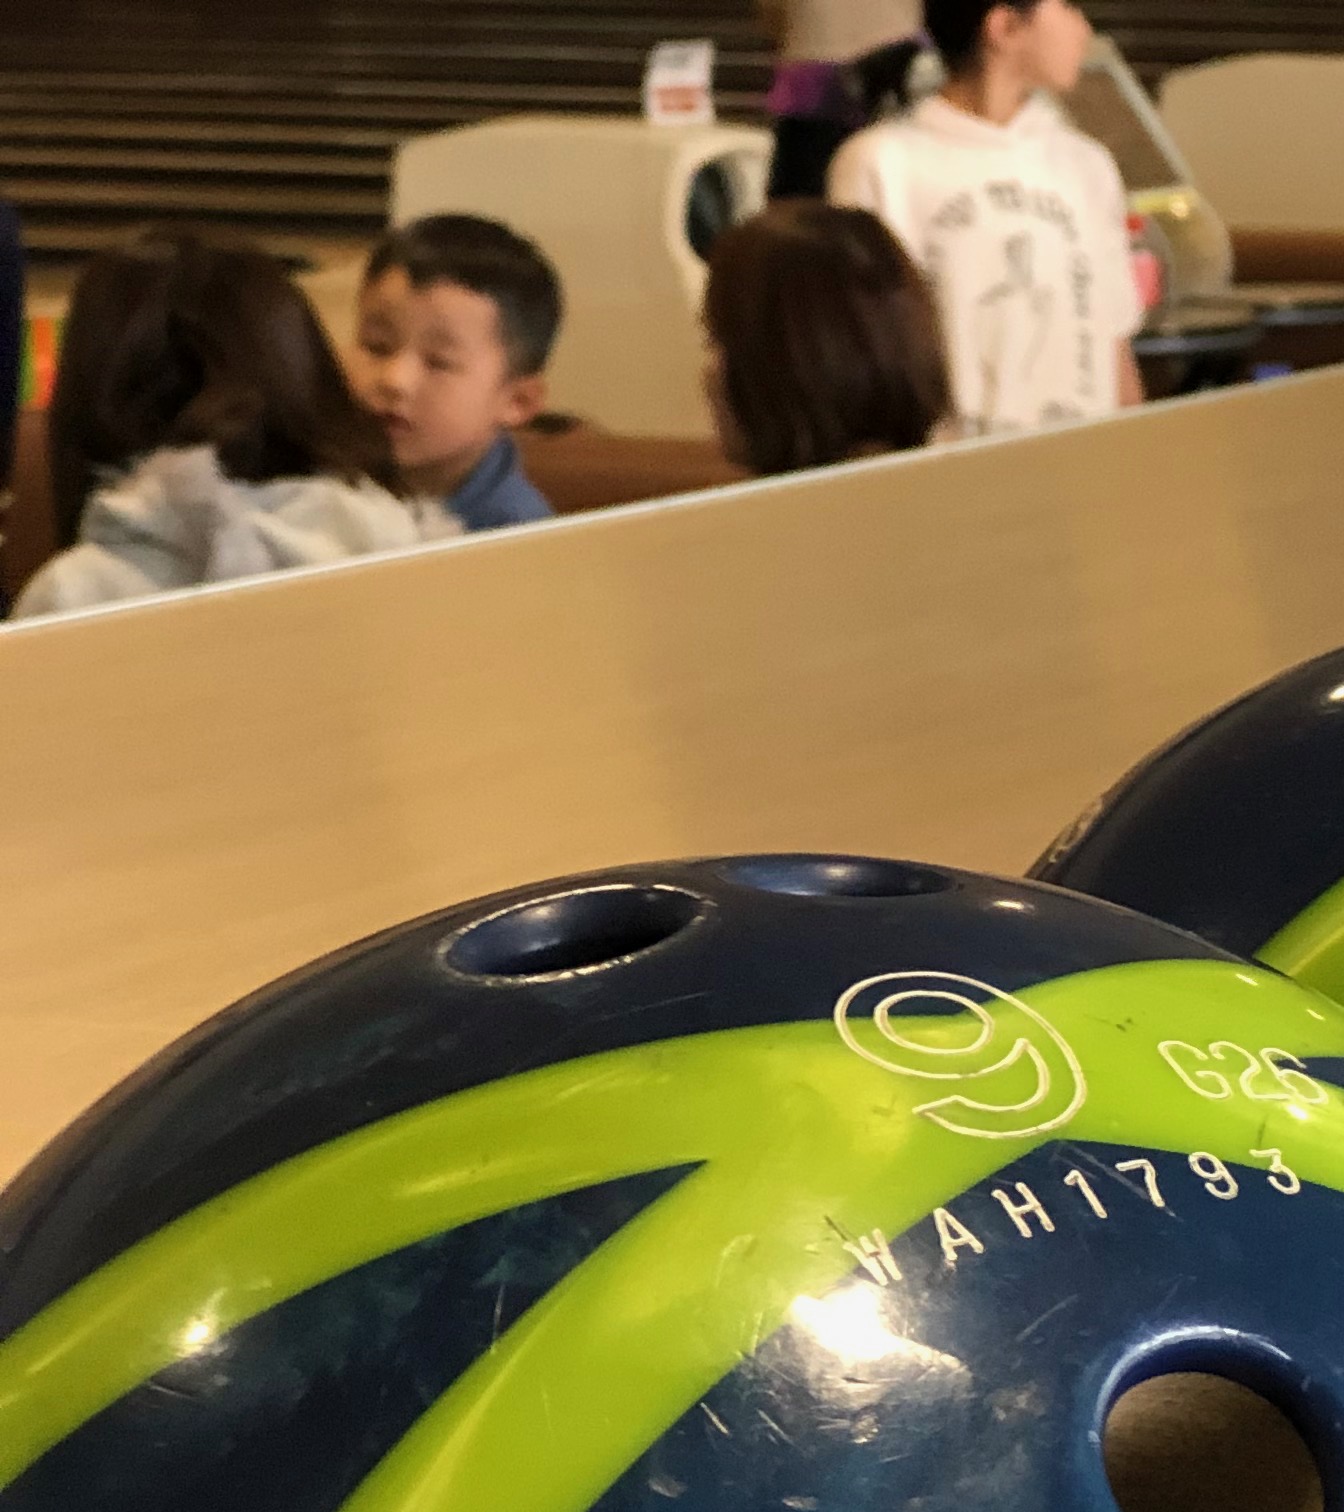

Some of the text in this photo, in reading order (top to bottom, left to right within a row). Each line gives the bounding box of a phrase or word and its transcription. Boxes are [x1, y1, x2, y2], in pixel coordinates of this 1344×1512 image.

[833, 970, 1087, 1139] 9
[1157, 1040, 1328, 1104] G26
[842, 1148, 1301, 1286] WAH1793
